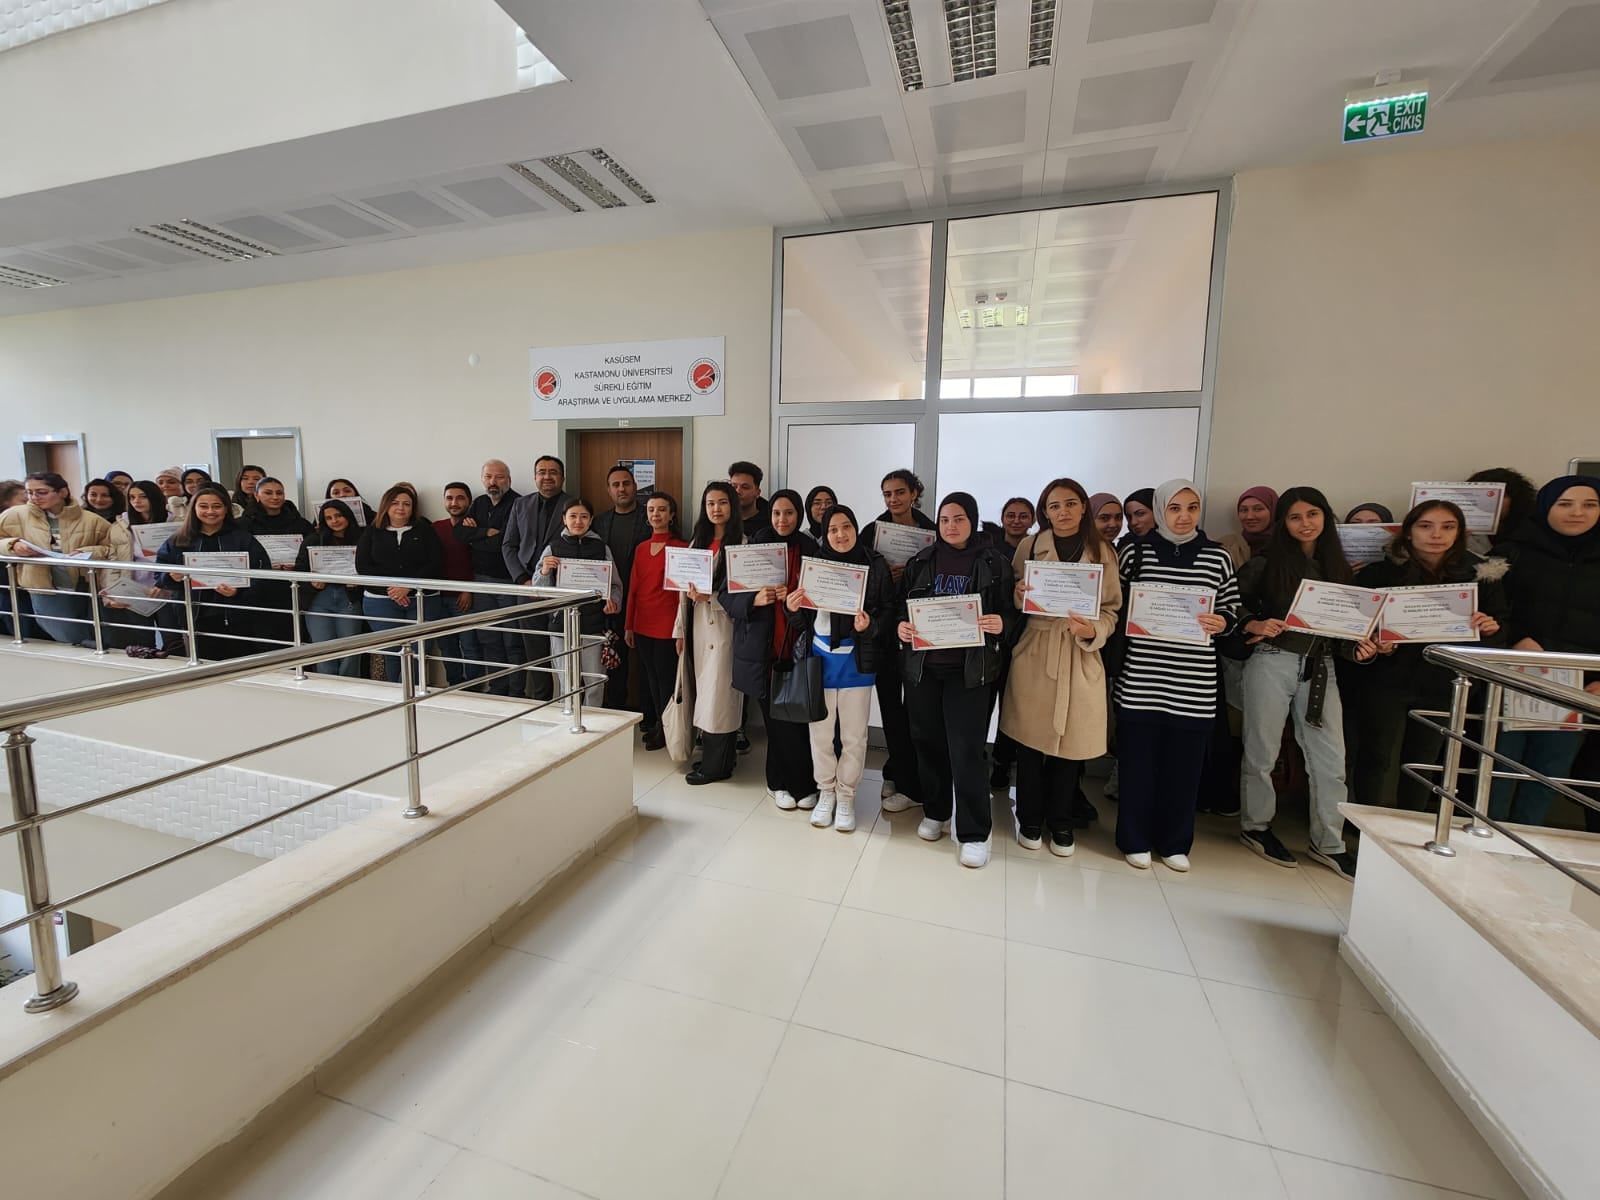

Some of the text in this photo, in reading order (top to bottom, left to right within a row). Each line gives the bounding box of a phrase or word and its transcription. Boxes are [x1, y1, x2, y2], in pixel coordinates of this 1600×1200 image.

[1394, 99, 1425, 116] EXIT
[1393, 114, 1422, 133] ÇIKIŞ
[604, 354, 641, 365] KASÜSEM
[574, 364, 673, 380] KASTAMONU ÜNİVERSİTESİ
[593, 380, 652, 392] SÜREKLİ EĞİTİM
[558, 391, 692, 407] ARAŞTIRMA VE UYGULAMA MERKEZİ
